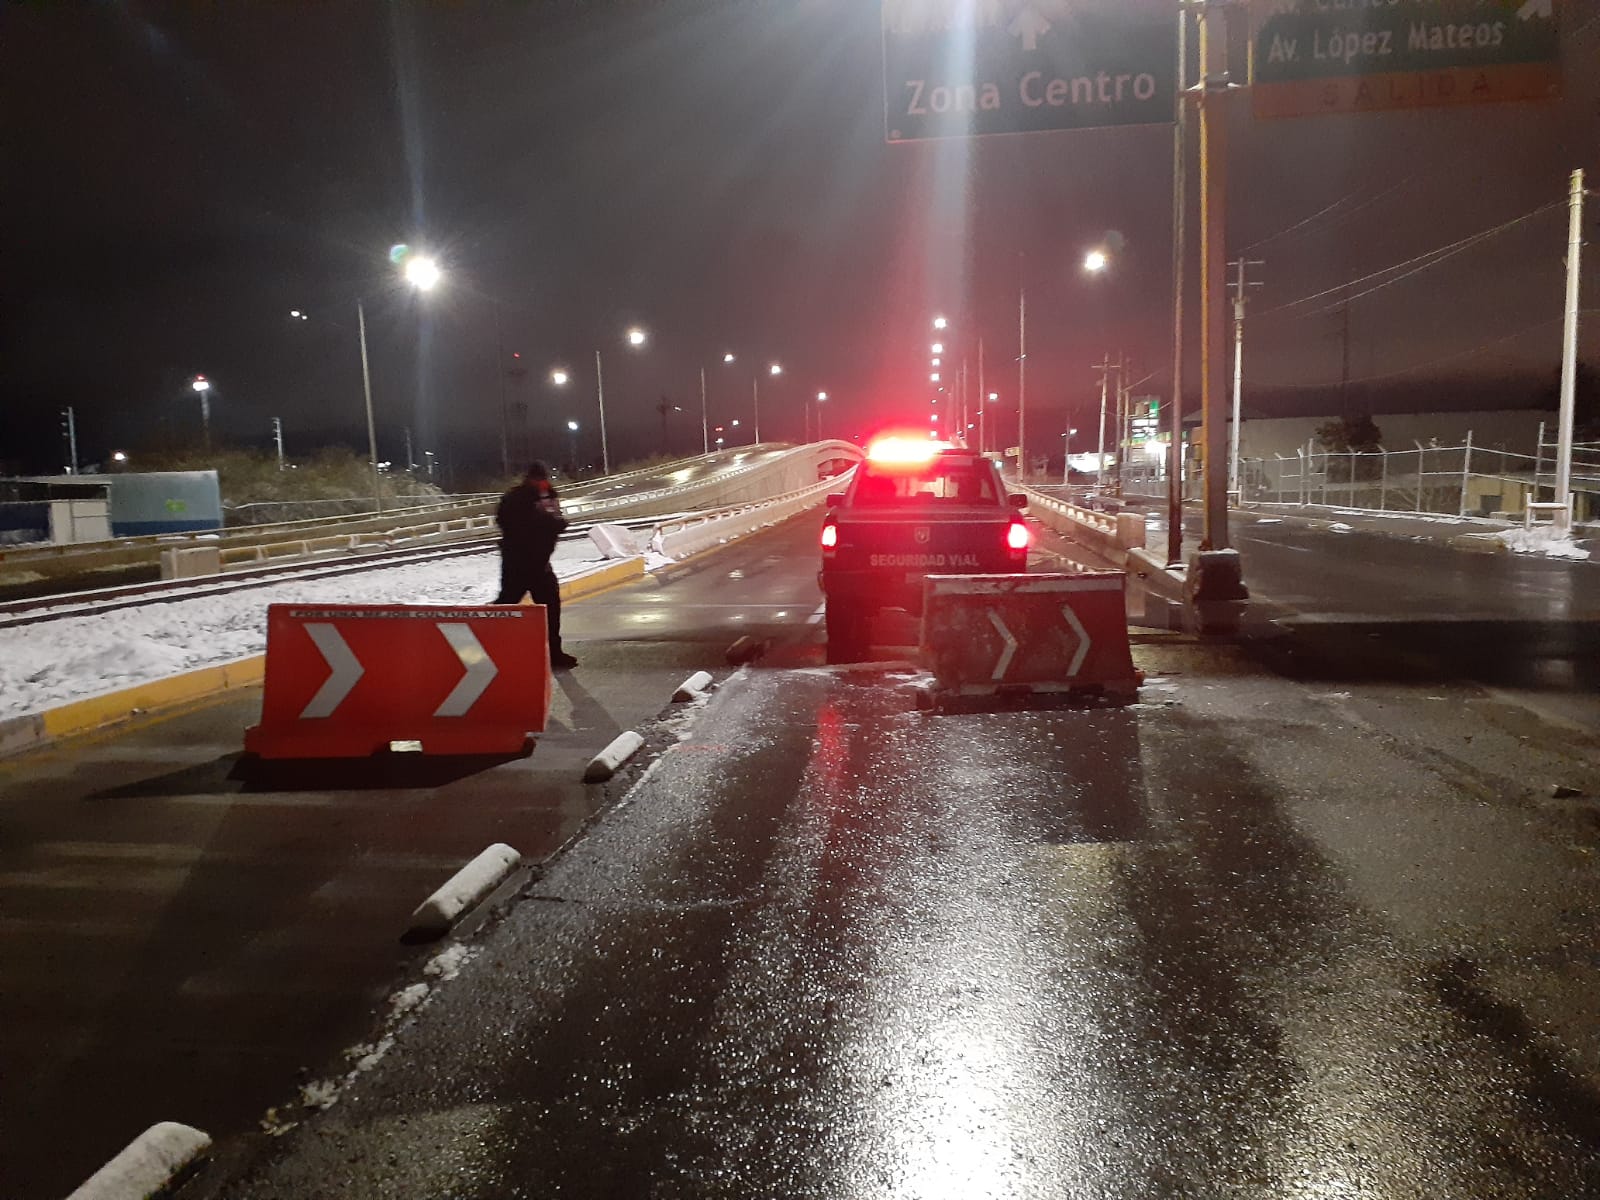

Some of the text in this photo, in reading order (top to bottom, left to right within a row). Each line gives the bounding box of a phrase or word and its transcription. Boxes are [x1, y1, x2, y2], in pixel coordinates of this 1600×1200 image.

[1313, 27, 1393, 65] López
[1407, 20, 1505, 50] Mateos
[904, 70, 1155, 115] Zona Centro
[1321, 71, 1491, 106] SALIDA
[869, 554, 979, 567] SEGURIDAD VIAL
[415, 610, 480, 619] CULTURA
[484, 610, 516, 619] VIAL
